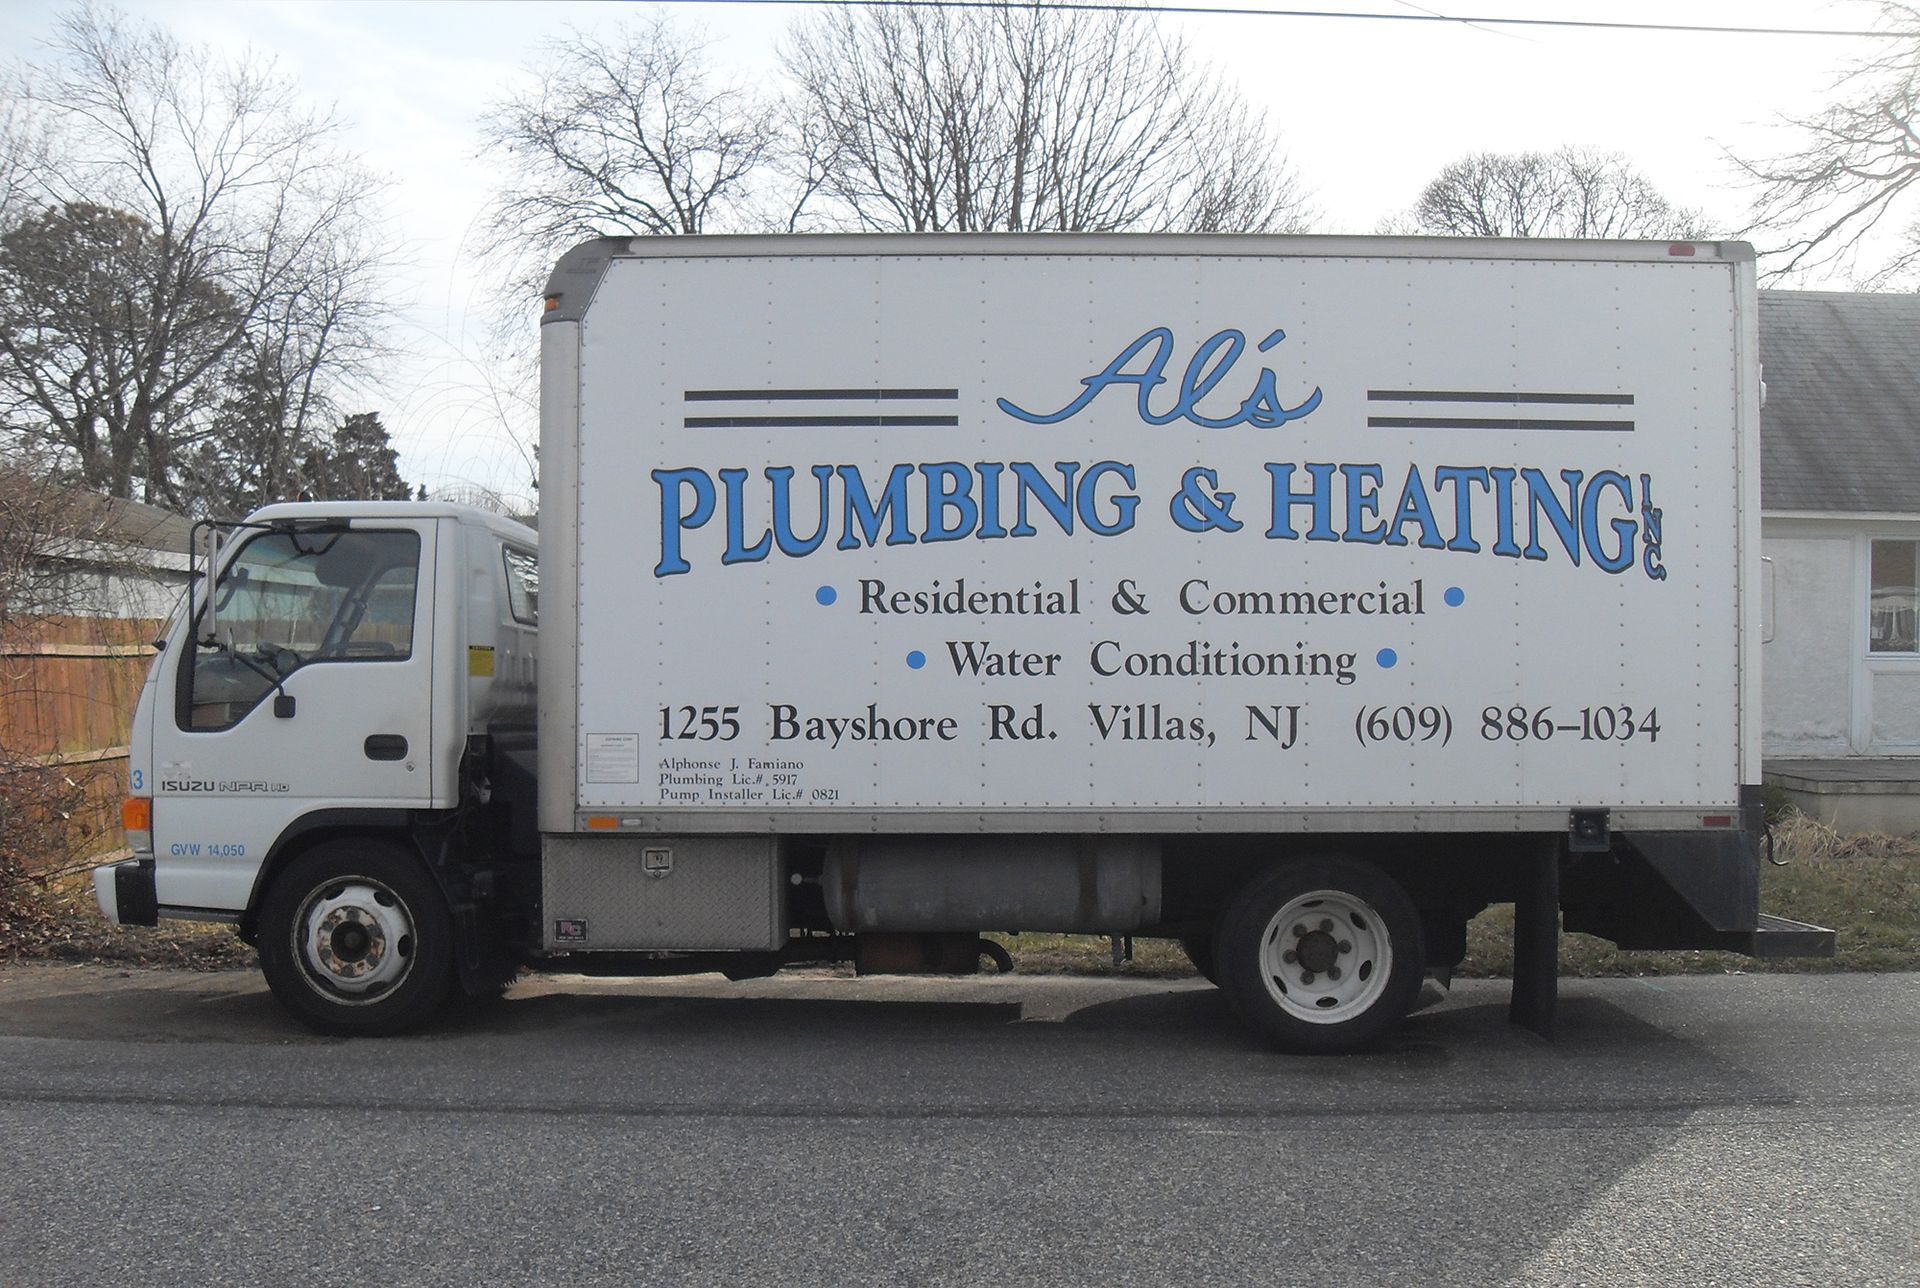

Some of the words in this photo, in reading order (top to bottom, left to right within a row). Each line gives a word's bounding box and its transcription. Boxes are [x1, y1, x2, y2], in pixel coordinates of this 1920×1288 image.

[996, 327, 1322, 429] Al's
[651, 461, 1141, 578] PLUMBING
[1170, 467, 1244, 533] &
[1264, 463, 1638, 574] HEATING
[1640, 473, 1667, 581] INC
[858, 578, 1080, 614] Residential
[1112, 580, 1150, 615] &
[1180, 579, 1425, 614] Commercial
[946, 641, 1061, 676] Water
[1091, 640, 1356, 685] Conditioning
[660, 706, 740, 741] 1255
[770, 703, 957, 749] Bayshore
[988, 704, 1057, 740] Rd.
[1088, 703, 1215, 748] Villas,
[1246, 706, 1300, 750] NJ
[1356, 705, 1452, 747] (609)
[1481, 704, 1661, 742] 886-1034
[660, 758, 721, 771] Alphonse
[729, 758, 739, 770] J.
[748, 758, 804, 769] Famiano
[130, 769, 144, 790] 3
[162, 781, 214, 791] ISUZU
[219, 782, 268, 792] NPR
[660, 773, 723, 786] Plumbing
[732, 773, 763, 785] Lic.#
[772, 773, 798, 785] 5917
[660, 788, 700, 802] Pump
[708, 788, 764, 800] Installer
[773, 789, 802, 799] Lic.#
[811, 788, 839, 801] 0821
[171, 844, 200, 855] GVW
[208, 845, 244, 857] 14,050
